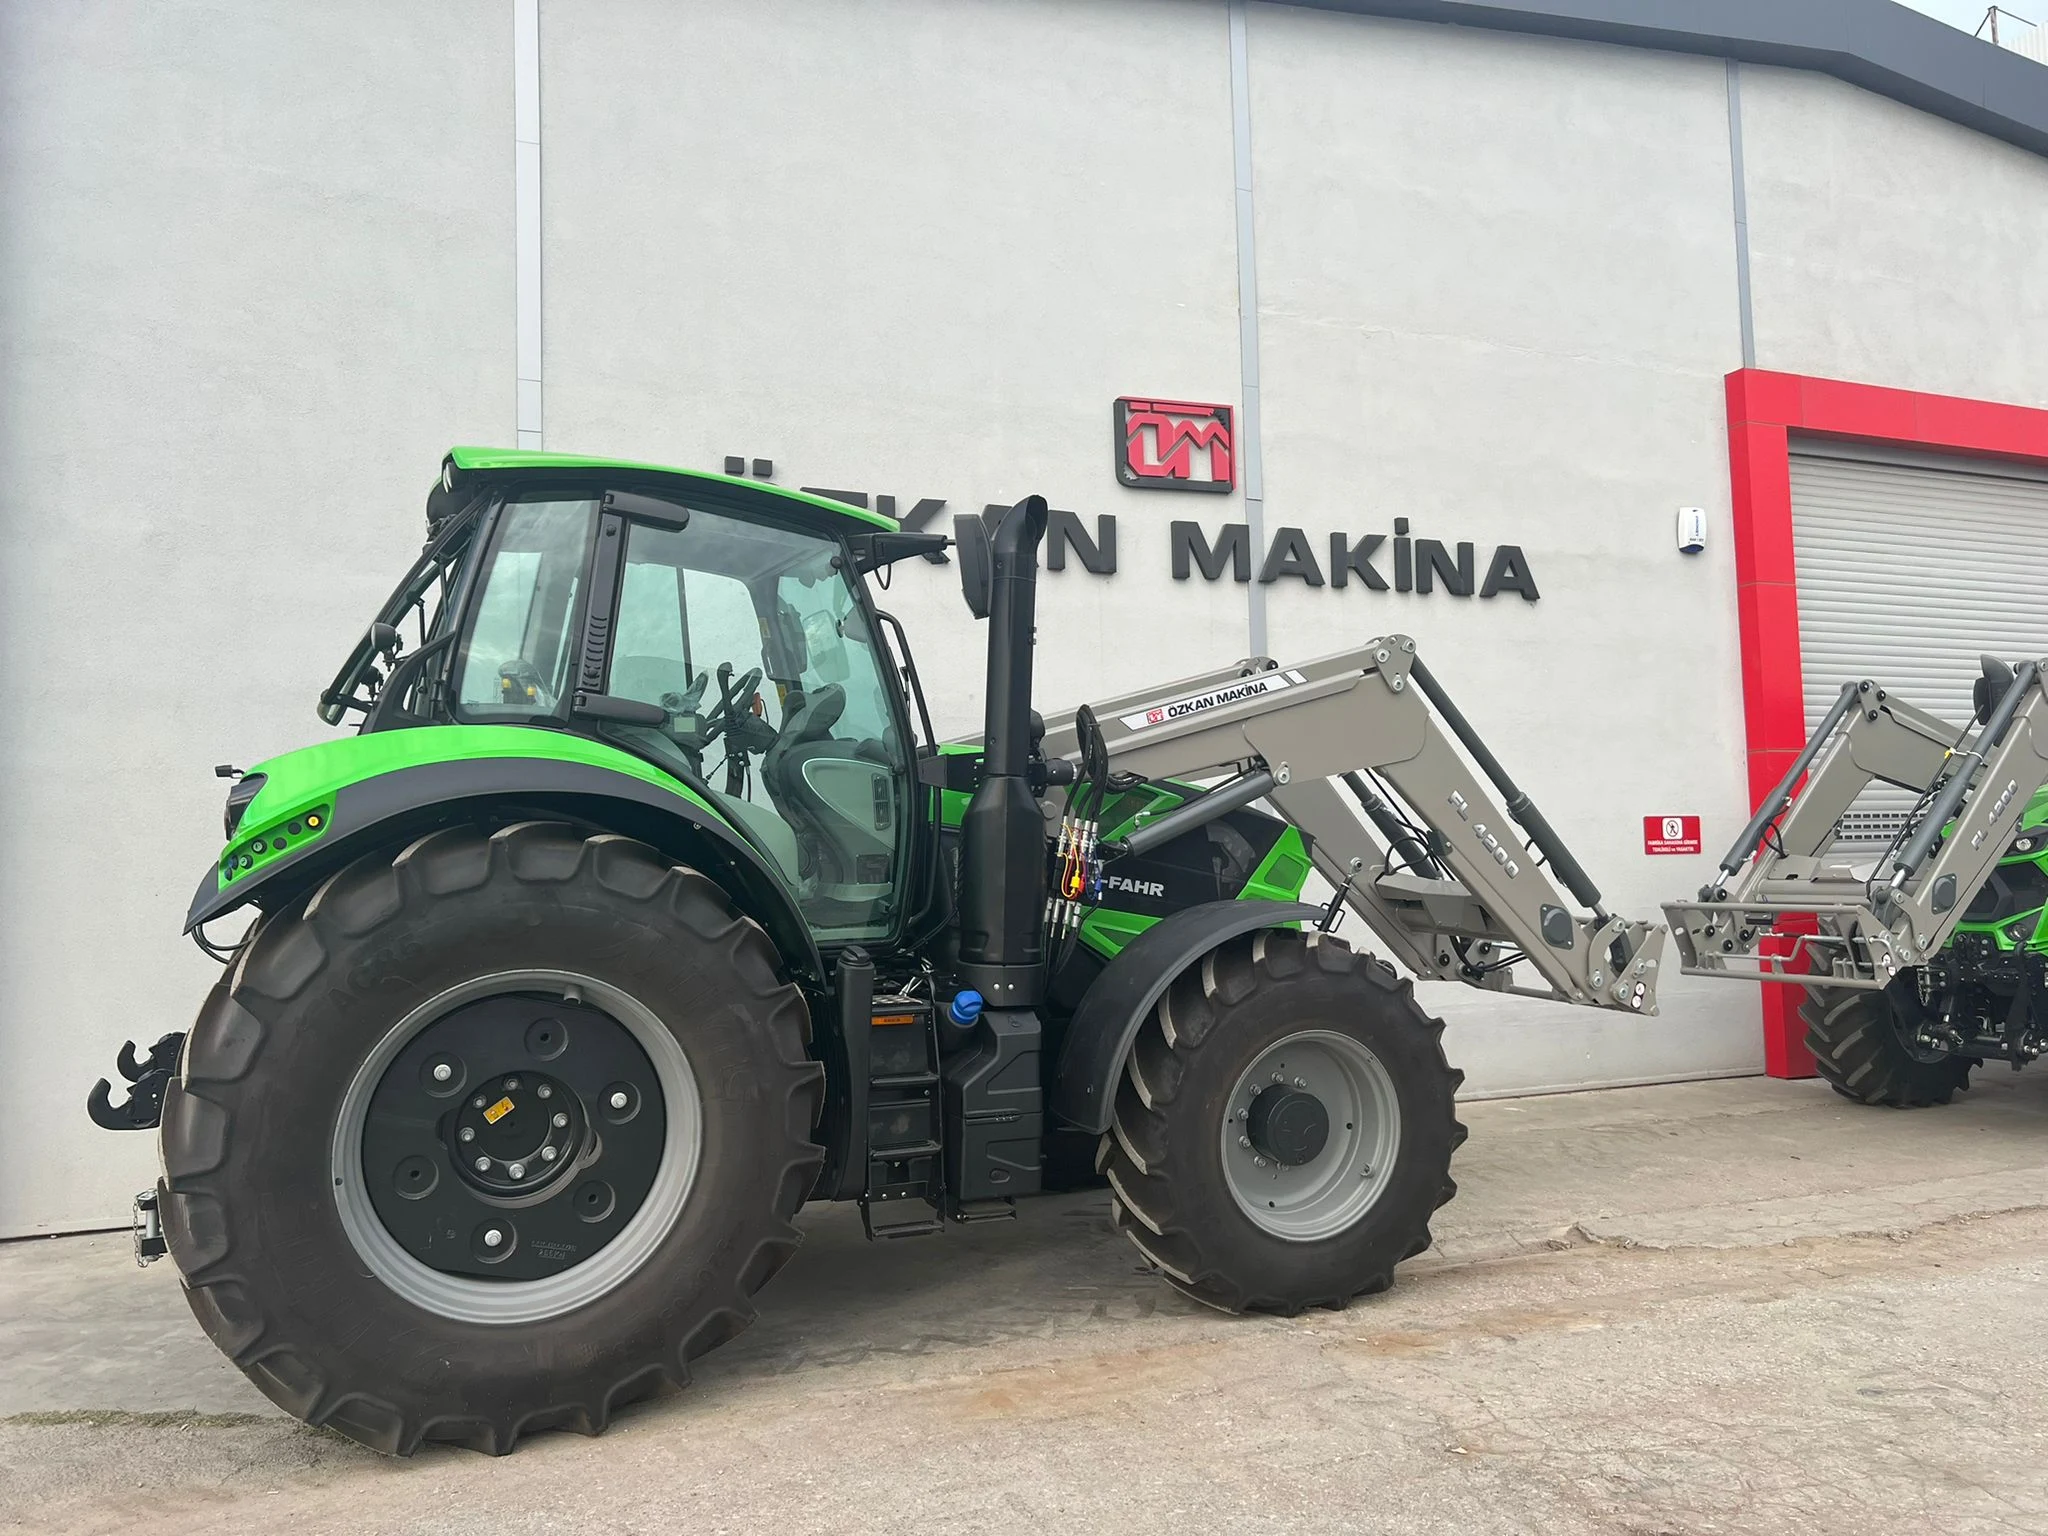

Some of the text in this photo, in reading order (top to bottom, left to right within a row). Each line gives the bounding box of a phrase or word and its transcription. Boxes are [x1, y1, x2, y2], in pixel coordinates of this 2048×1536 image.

[1170, 517, 1540, 600] MAKİNA
[1168, 697, 1214, 717] ÖZKAN
[1216, 682, 1268, 704] MAKİNA
[1448, 790, 1519, 879] FL 4200
